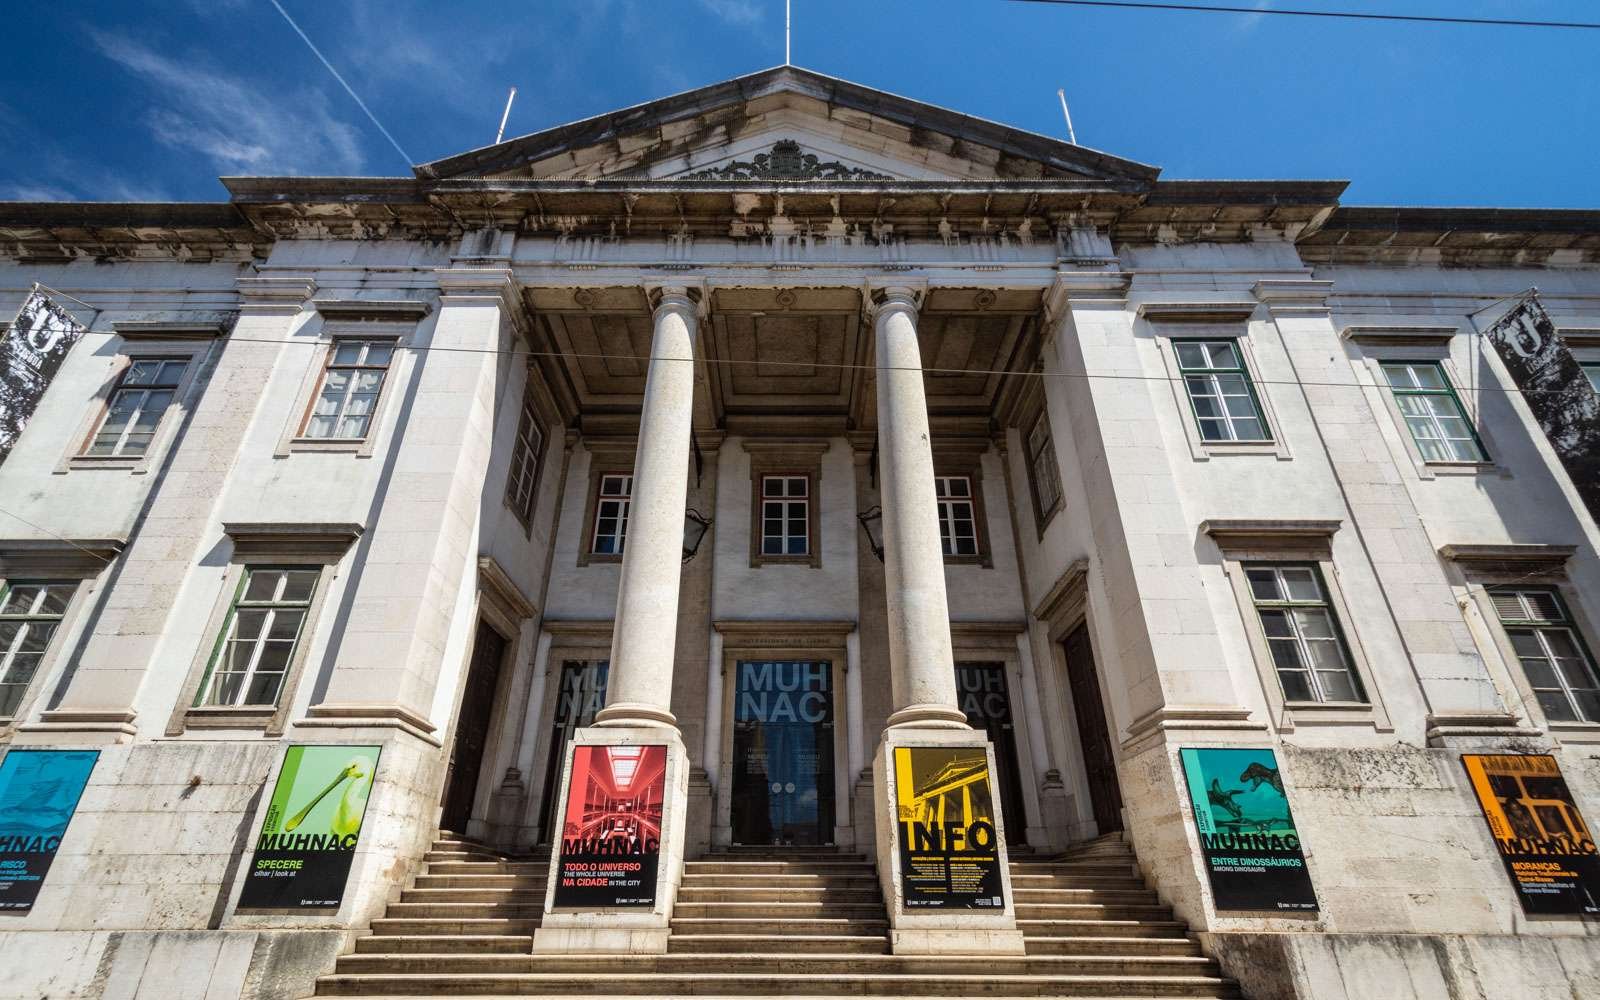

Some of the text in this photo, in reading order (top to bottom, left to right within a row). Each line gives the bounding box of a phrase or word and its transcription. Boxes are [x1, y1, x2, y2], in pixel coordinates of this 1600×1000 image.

[562, 667, 609, 691] MU
[743, 663, 827, 691] MUH
[955, 668, 1005, 692] UH
[559, 692, 605, 718] NA
[741, 691, 826, 722] NAC
[963, 693, 1007, 718] AC
[0, 836, 60, 852] HNAC
[257, 834, 358, 850] MUHNAC
[899, 820, 996, 852] INFO
[1202, 833, 1300, 850] MUHNAC
[257, 860, 303, 869] SPECERE
[565, 863, 641, 871] TODO O UNIVERSO
[1212, 856, 1302, 867] ENTRE DINOSSÁURIOS
[563, 878, 575, 886] NA
[577, 878, 608, 886] CIDADE
